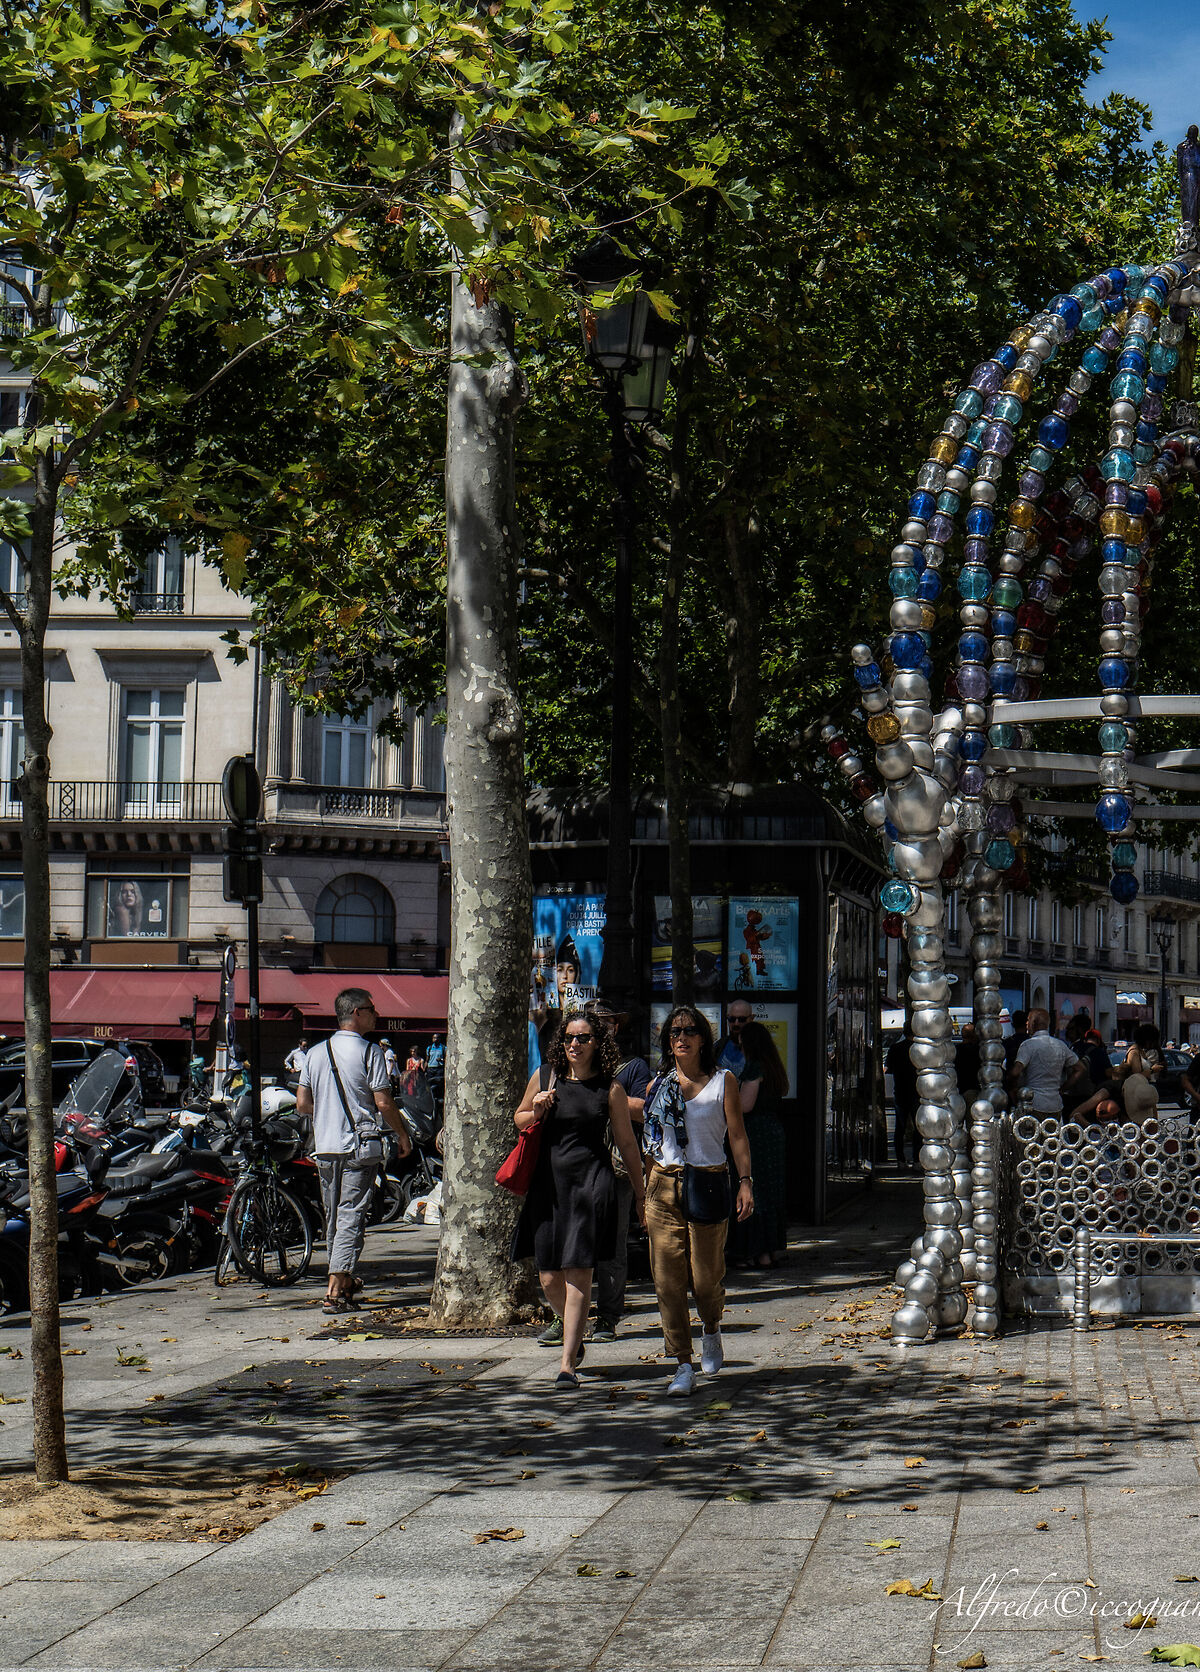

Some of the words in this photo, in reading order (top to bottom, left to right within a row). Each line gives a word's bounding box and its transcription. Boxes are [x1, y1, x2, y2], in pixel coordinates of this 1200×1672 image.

[244, 1007, 265, 1019] RC
[387, 1019, 406, 1031] RUC
[94, 1026, 114, 1037] RUC
